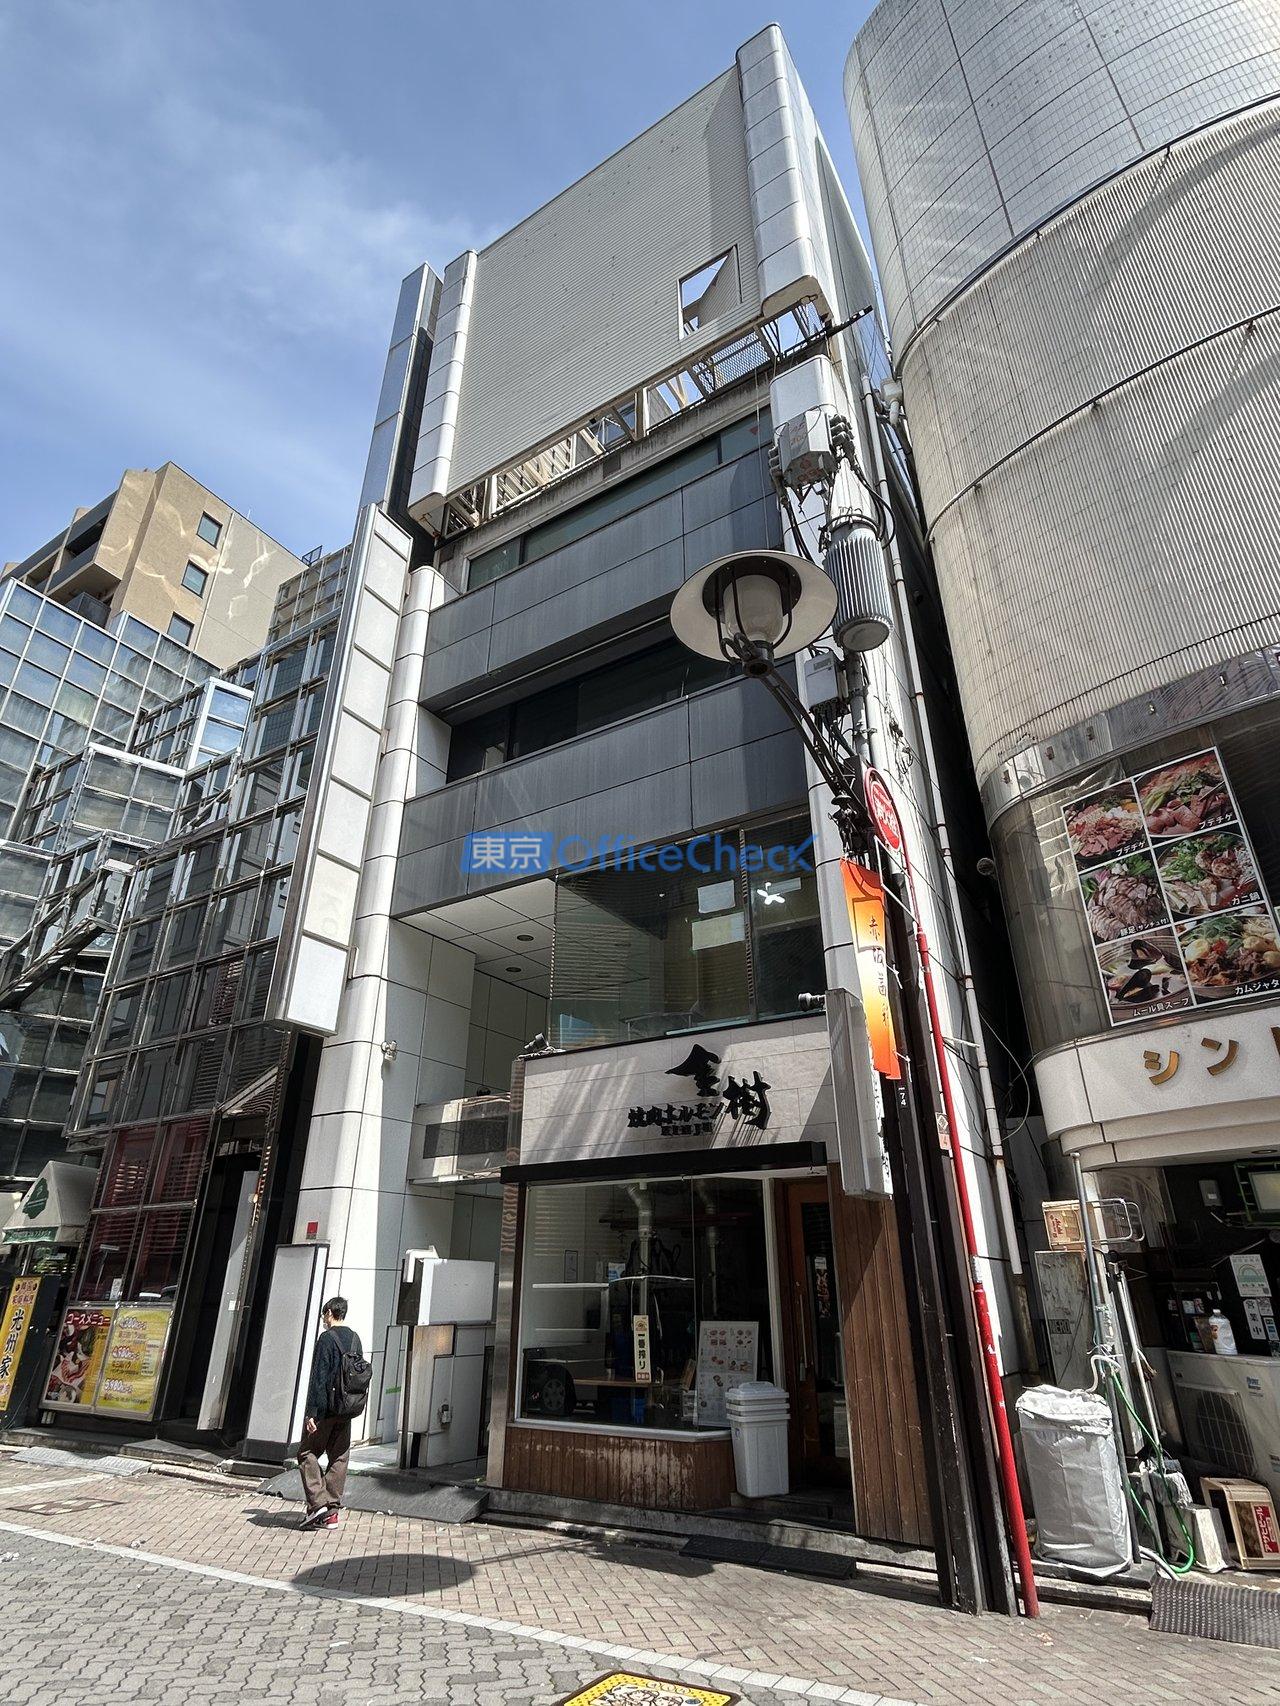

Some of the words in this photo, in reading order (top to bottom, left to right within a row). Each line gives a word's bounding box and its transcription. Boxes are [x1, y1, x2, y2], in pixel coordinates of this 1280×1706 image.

[1143, 1026, 1280, 1086] シン
[627, 1101, 725, 1128] 焼肉ホルモン
[0, 1308, 26, 1379] 光州家
